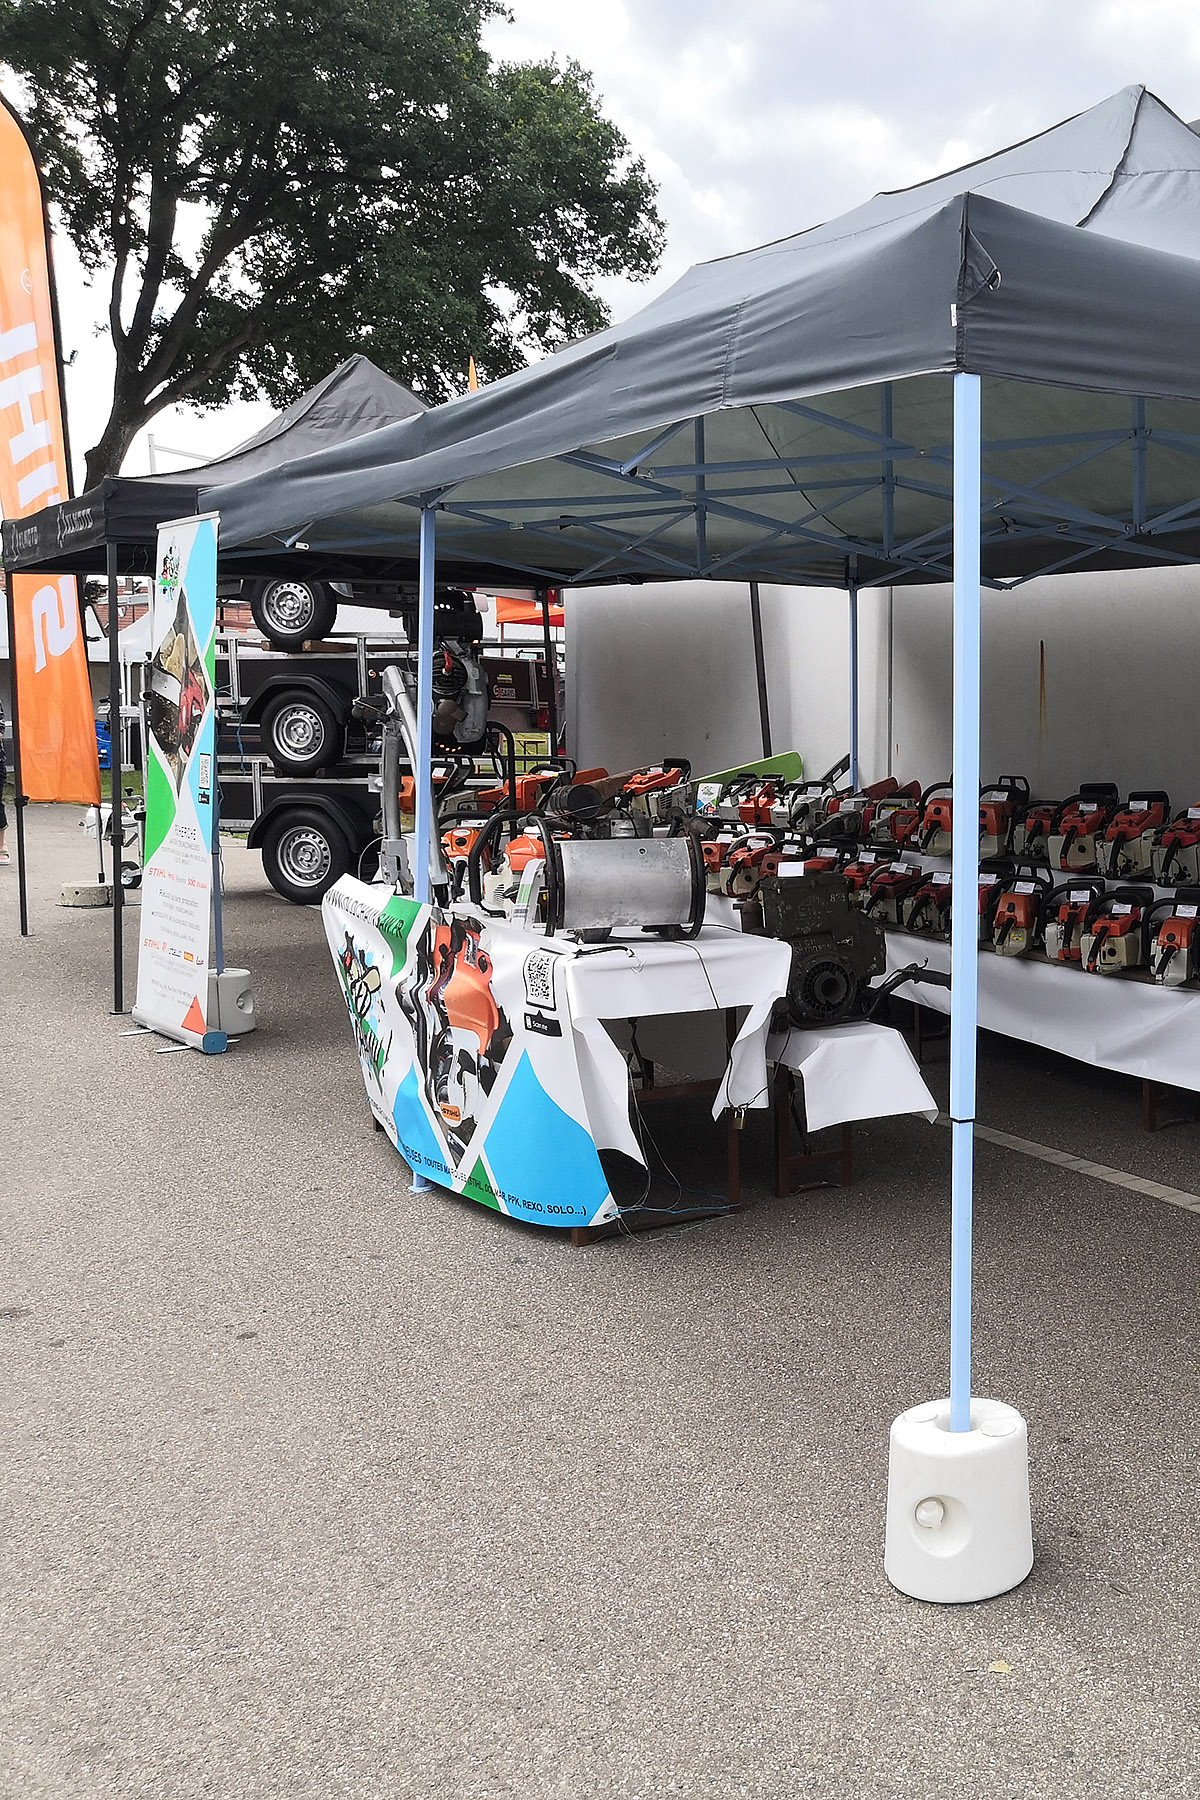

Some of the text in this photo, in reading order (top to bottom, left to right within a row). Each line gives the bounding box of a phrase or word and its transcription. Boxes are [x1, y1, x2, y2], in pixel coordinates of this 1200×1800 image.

[148, 867, 167, 879] STIHL
[143, 938, 160, 950] STIHL
[423, 1156, 444, 1173] TOUTES
